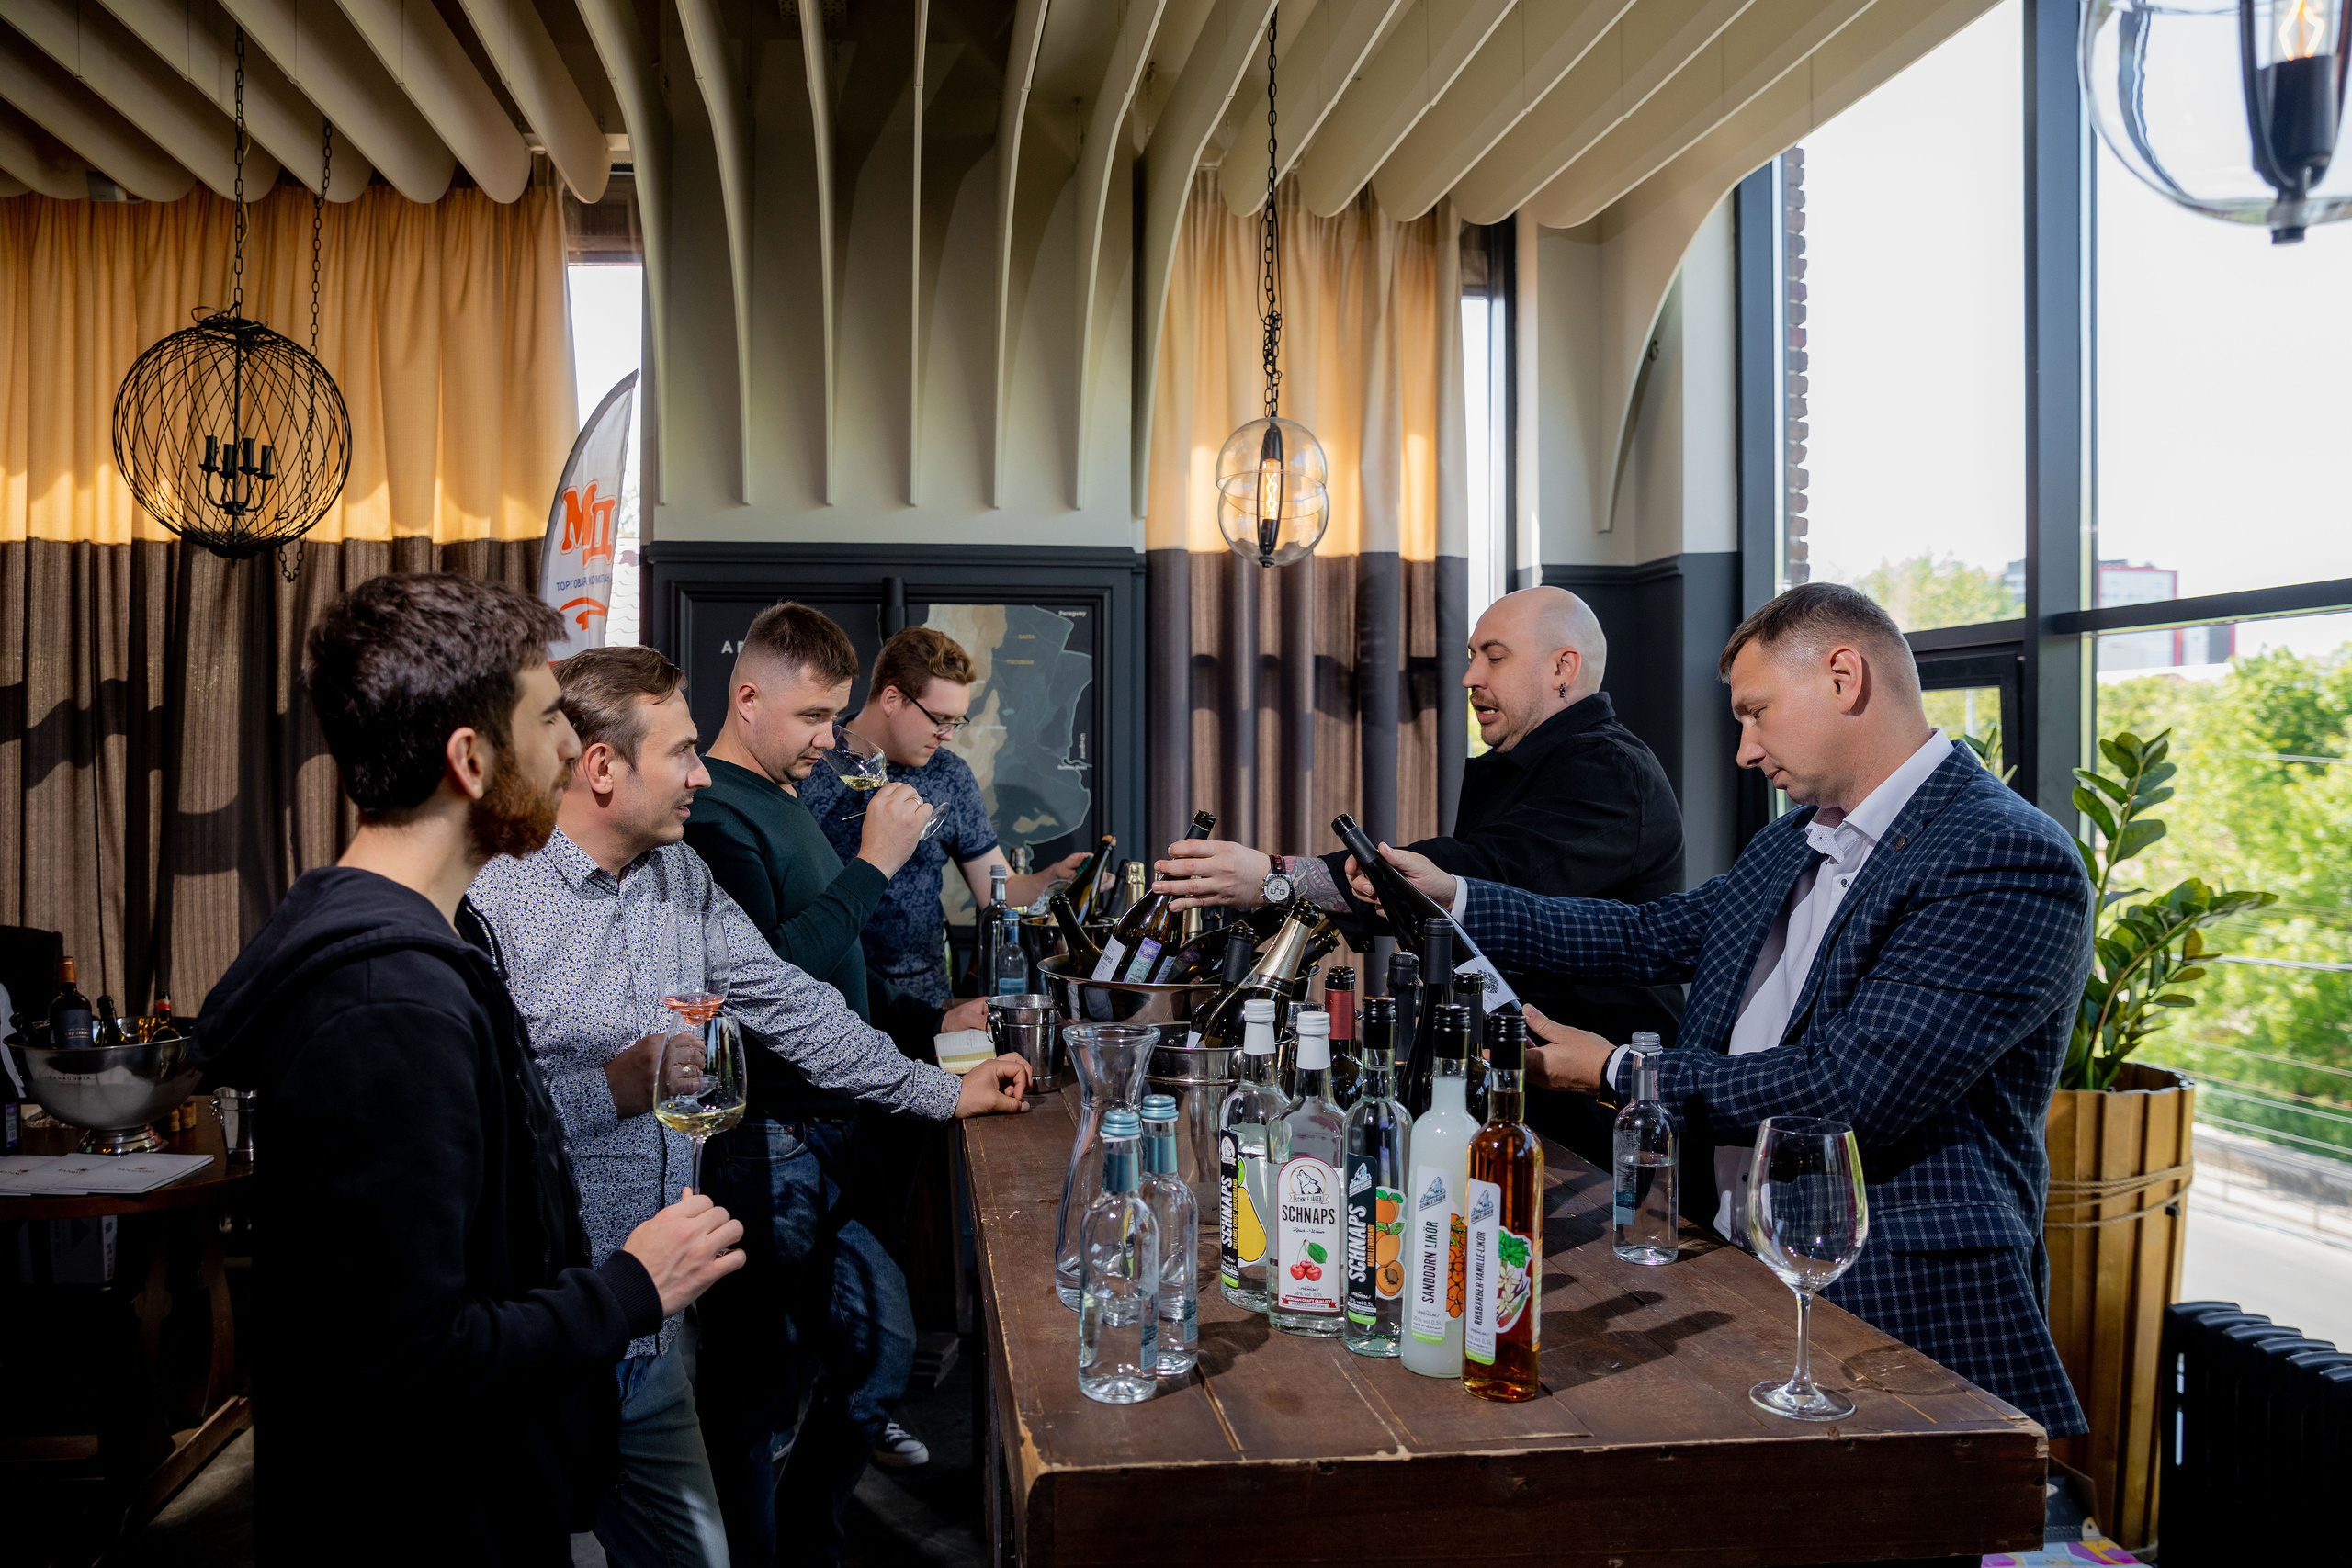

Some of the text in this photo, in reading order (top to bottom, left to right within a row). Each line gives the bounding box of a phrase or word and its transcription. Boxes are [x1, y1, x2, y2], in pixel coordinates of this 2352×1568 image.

[1220, 1174, 1233, 1248] SCHNAPS
[1282, 1204, 1336, 1224] SCHNAPS
[1348, 1203, 1367, 1283] SCHNAPS
[1421, 1221, 1439, 1303] SANDDORN LIKÖR
[1474, 1231, 1487, 1325] RHABARBER-VANILLE-LIKÖR
